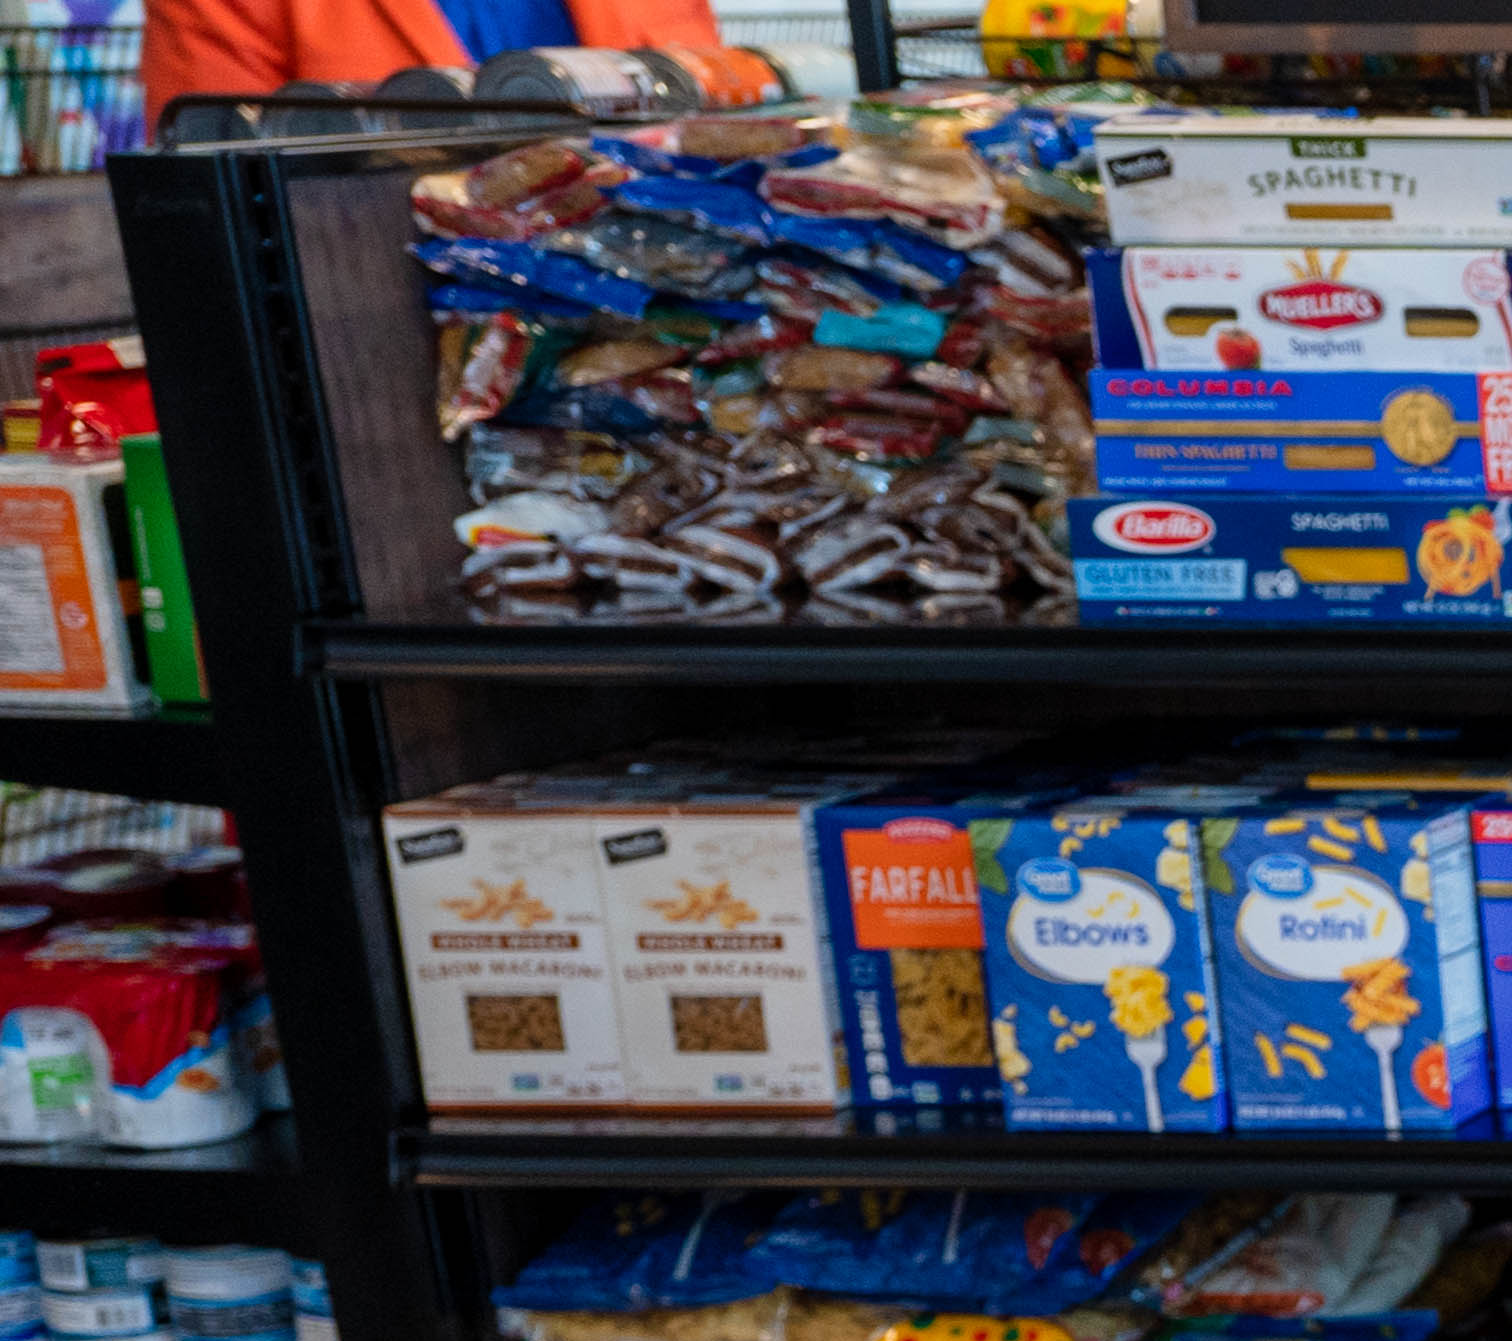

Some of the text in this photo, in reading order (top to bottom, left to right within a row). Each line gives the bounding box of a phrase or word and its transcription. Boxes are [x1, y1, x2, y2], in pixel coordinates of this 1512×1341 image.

[1248, 167, 1417, 199] SPAGHETTI
[1266, 289, 1377, 318] MUELLER'S
[1289, 337, 1363, 357] Spaghetti
[1106, 380, 1293, 397] COLUMBIA
[1114, 515, 1205, 539] Barilla
[1291, 514, 1389, 531] SPAGHETTI
[1086, 566, 1236, 585] GLUTEN FREE
[1035, 918, 1149, 946] Elbows
[1280, 914, 1367, 942] Rotini
